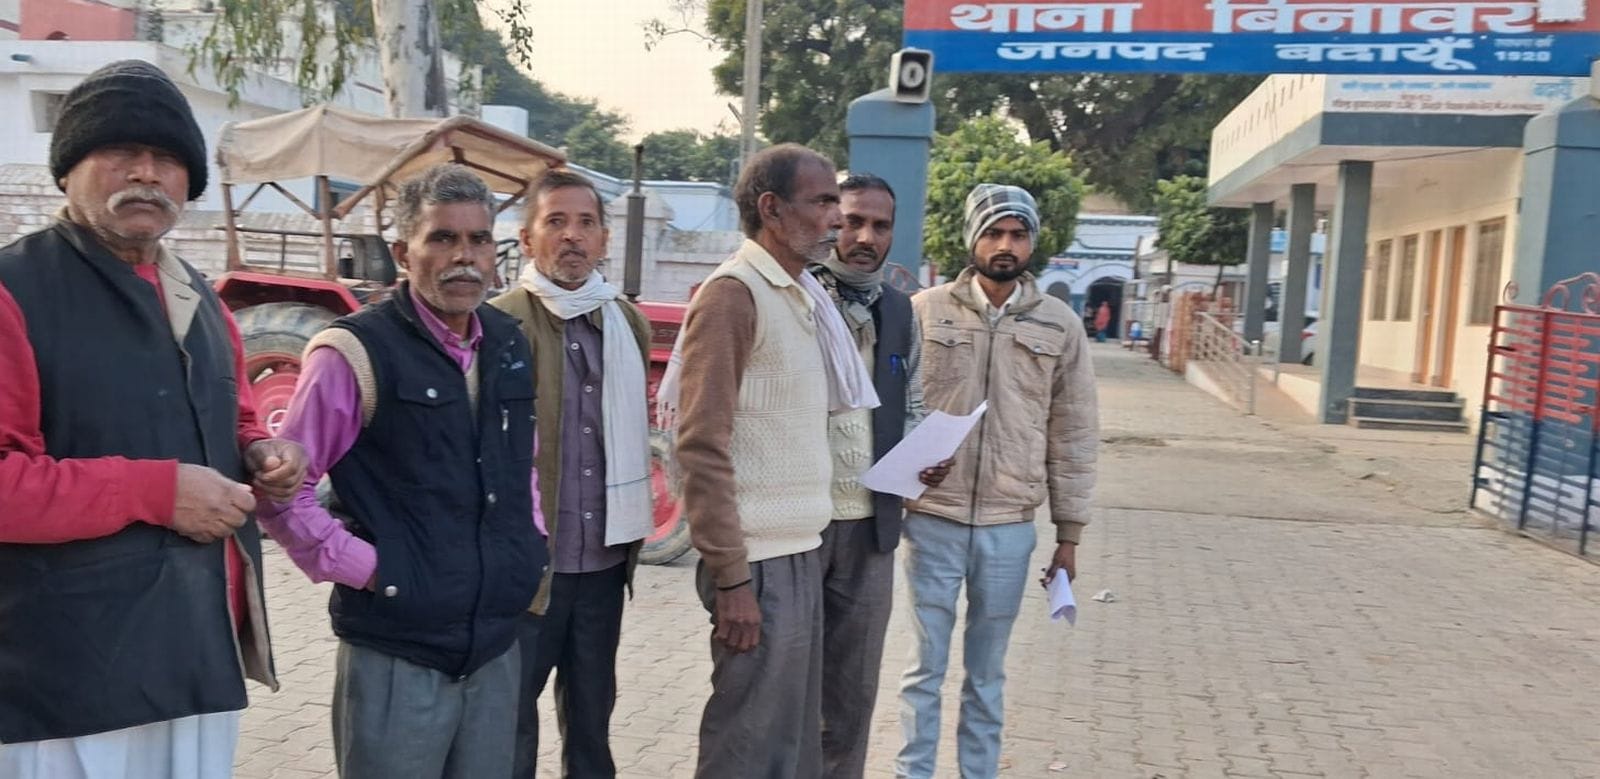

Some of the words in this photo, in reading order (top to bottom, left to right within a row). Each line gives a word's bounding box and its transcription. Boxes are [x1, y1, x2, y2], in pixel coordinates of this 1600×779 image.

[950, 3, 1142, 32] थाना
[1206, 0, 1535, 33] बिनावर
[997, 42, 1213, 60] जनपद
[1274, 36, 1477, 70] बदायूँ
